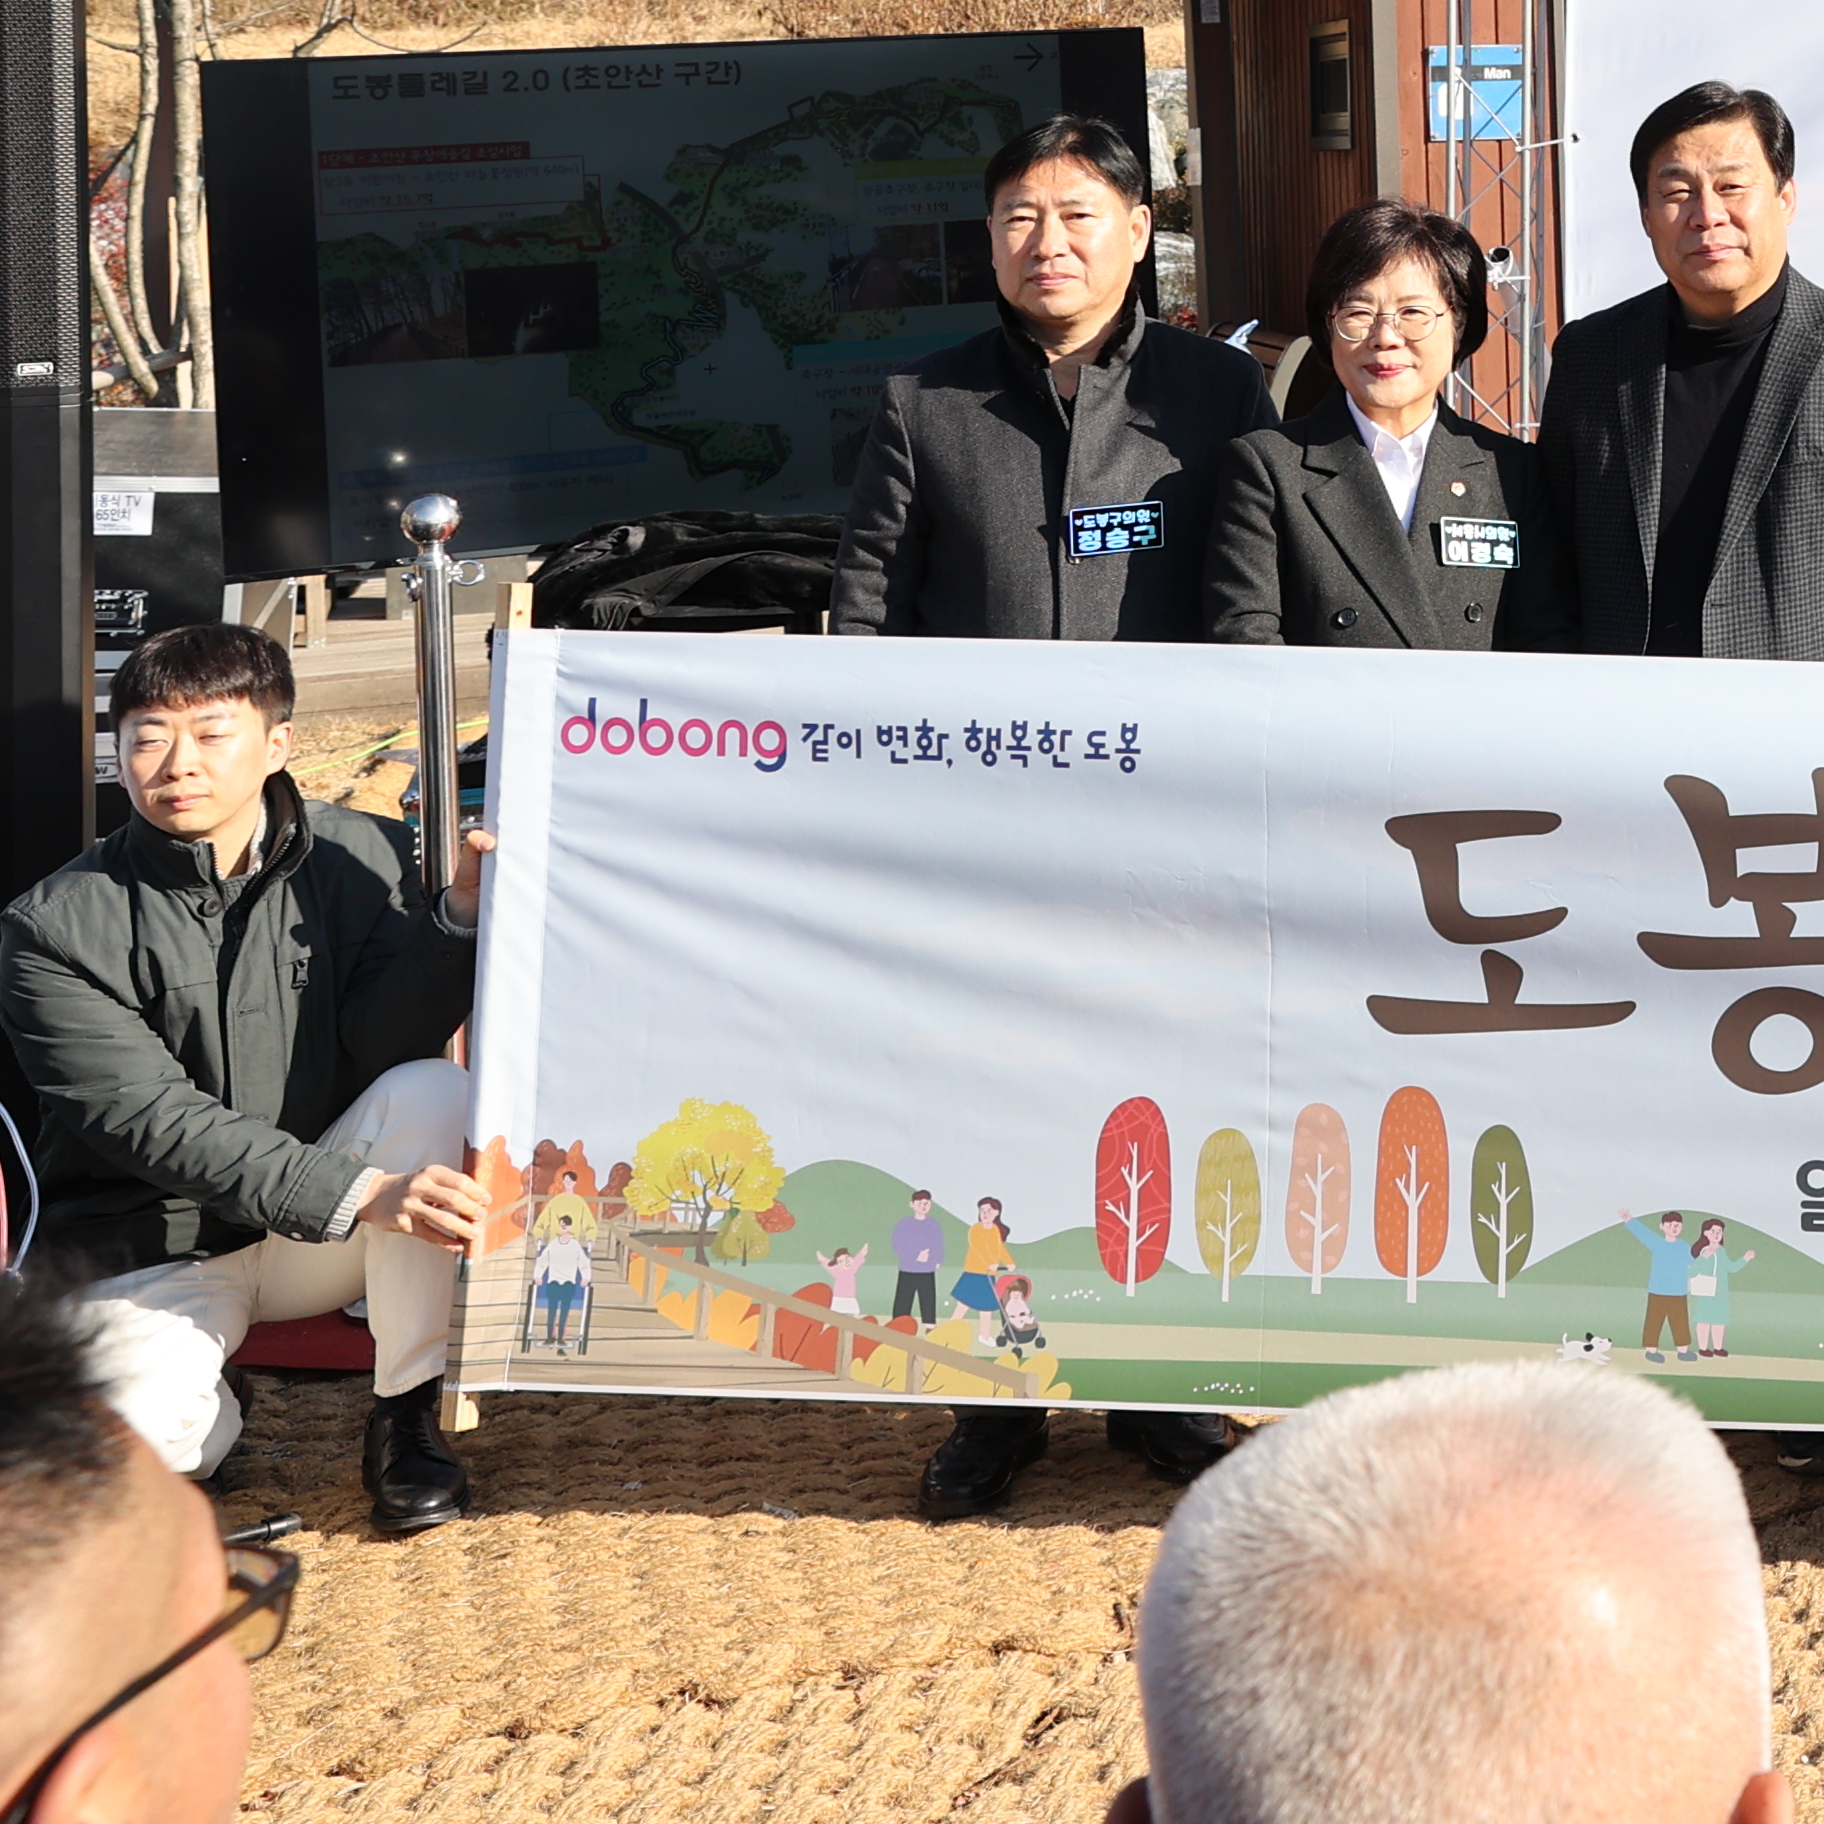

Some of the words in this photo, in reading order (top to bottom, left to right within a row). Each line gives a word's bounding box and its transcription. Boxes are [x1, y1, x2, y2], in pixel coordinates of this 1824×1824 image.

[332, 70, 489, 101] 도봉둘레길
[502, 69, 550, 93] 2.0
[562, 62, 664, 92] (초안산
[674, 60, 741, 86] 구간)
[1484, 68, 1511, 79] Man
[125, 495, 142, 506] TV
[96, 509, 131, 521] 65인치
[1083, 509, 1150, 528] 도봉구의원
[1078, 525, 1156, 551] 정승구
[1448, 541, 1514, 564] 이경숙
[561, 697, 787, 773] dobong
[801, 723, 861, 762] 같이
[877, 718, 953, 768] 변화,
[963, 719, 1073, 768] 행복한
[1084, 723, 1141, 773] 도봉
